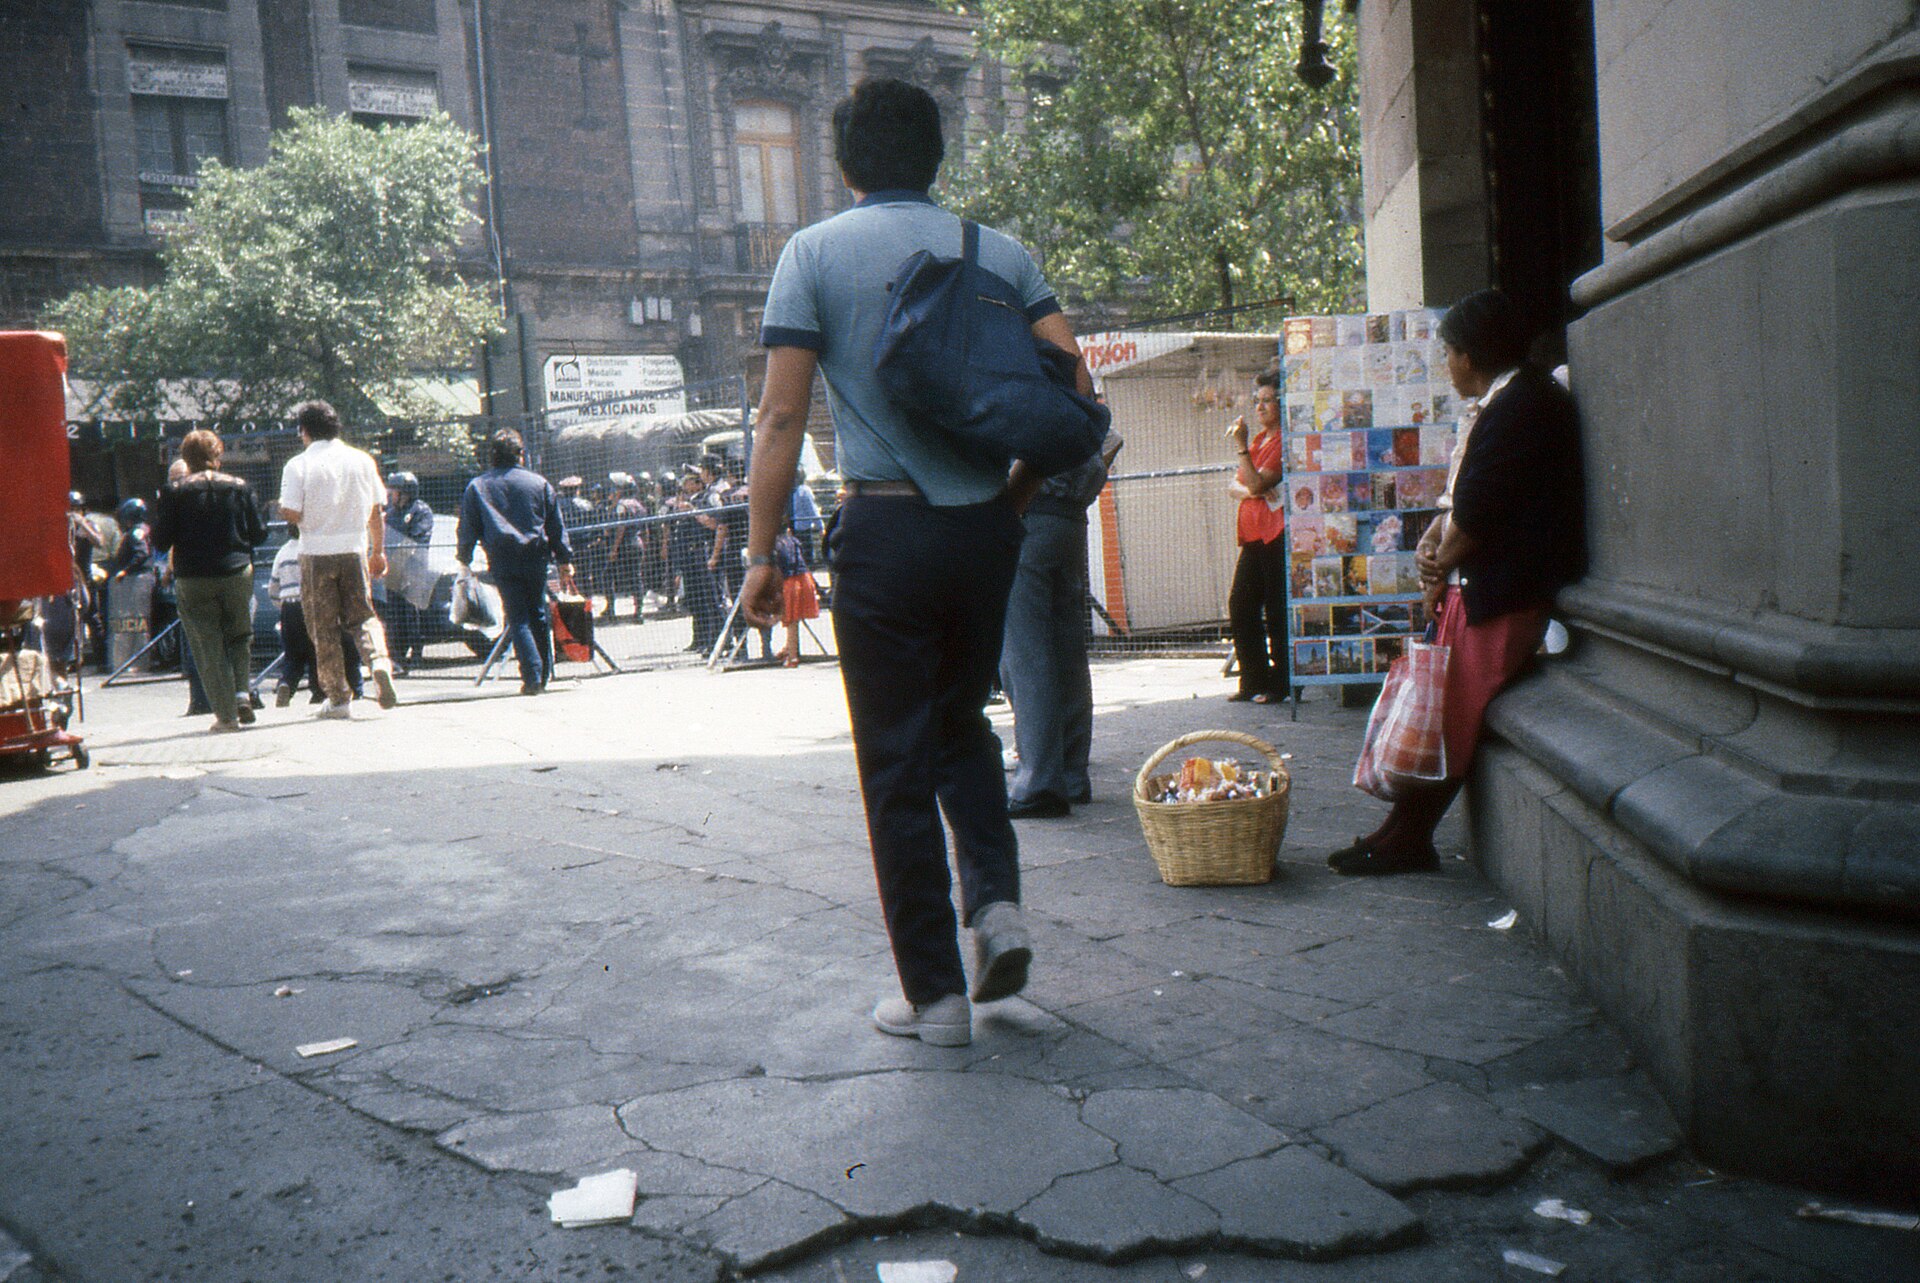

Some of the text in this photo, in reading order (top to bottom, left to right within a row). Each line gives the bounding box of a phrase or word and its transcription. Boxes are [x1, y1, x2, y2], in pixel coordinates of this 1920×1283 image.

[587, 368, 622, 377] Medallas
[588, 380, 615, 388] Placas
[550, 390, 625, 402] MANUFACTURAS
[577, 403, 657, 417] MEXICANAS
